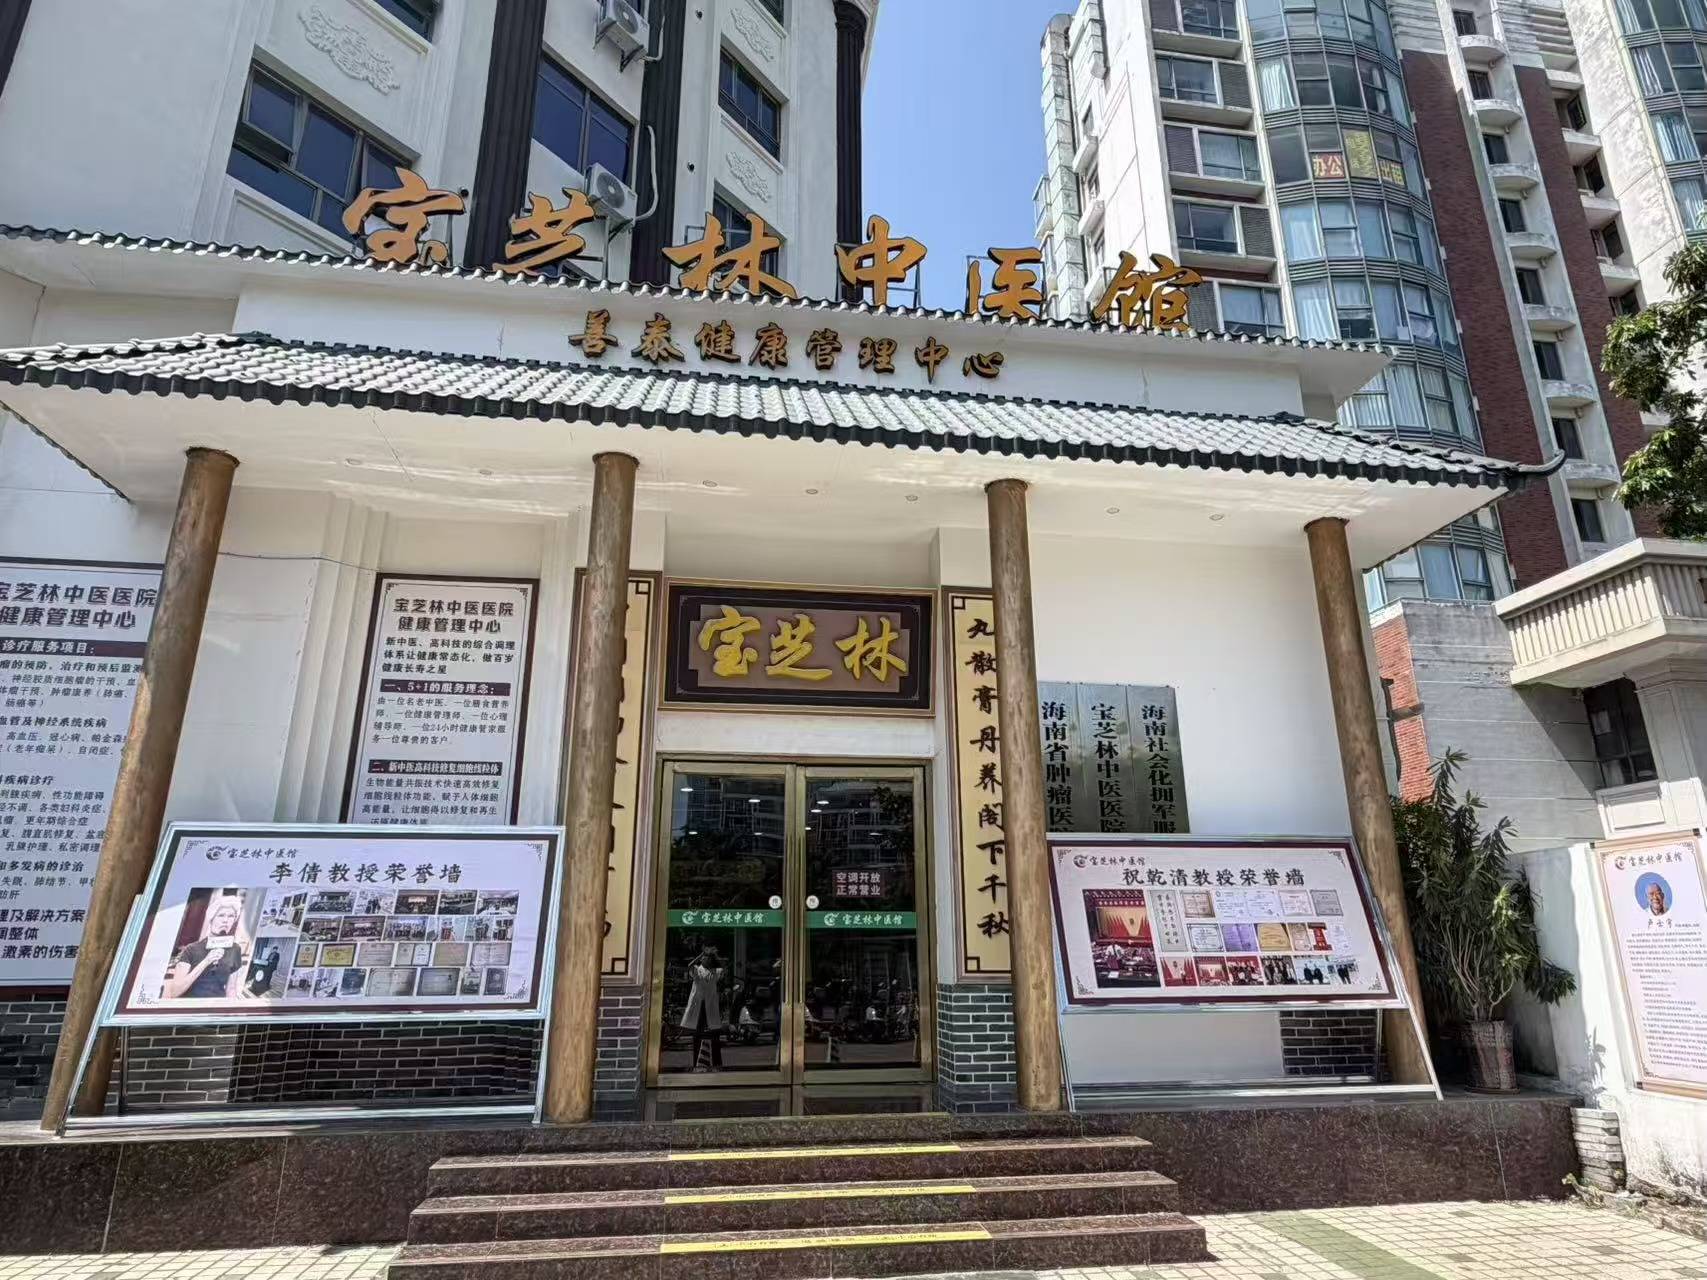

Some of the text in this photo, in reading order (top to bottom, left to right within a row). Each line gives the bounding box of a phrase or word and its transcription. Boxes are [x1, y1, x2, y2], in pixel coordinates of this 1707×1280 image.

[1312, 154, 1343, 177] 办公
[342, 166, 1202, 333] 宝芝林中医馆
[568, 308, 1005, 384] 善泰健康管理中心
[393, 598, 514, 617] 宝芝林中医医院
[0, 606, 136, 630] 健康管理中心
[398, 616, 501, 634] 健康管理中心
[698, 605, 908, 682] 宝芝林
[381, 662, 448, 675] 健康长寿之星
[6, 730, 128, 744] 高血压、冠心病、帕金森
[1041, 700, 1075, 832] 海南省肿瘤医
[0, 774, 54, 786] 疾病诊疗
[227, 846, 298, 860] 宝芝林中医馆
[1088, 855, 1147, 868] 宝芝林中医馆
[269, 862, 464, 885] 李倩教授荣誉墙
[836, 872, 881, 884] 空调开放
[1121, 868, 1306, 887] 祝乾清教授荣誉墙
[836, 884, 881, 896] 正常营业
[701, 912, 765, 925] 宝芝林中医馆
[841, 914, 903, 926] 宝芝林中医馆
